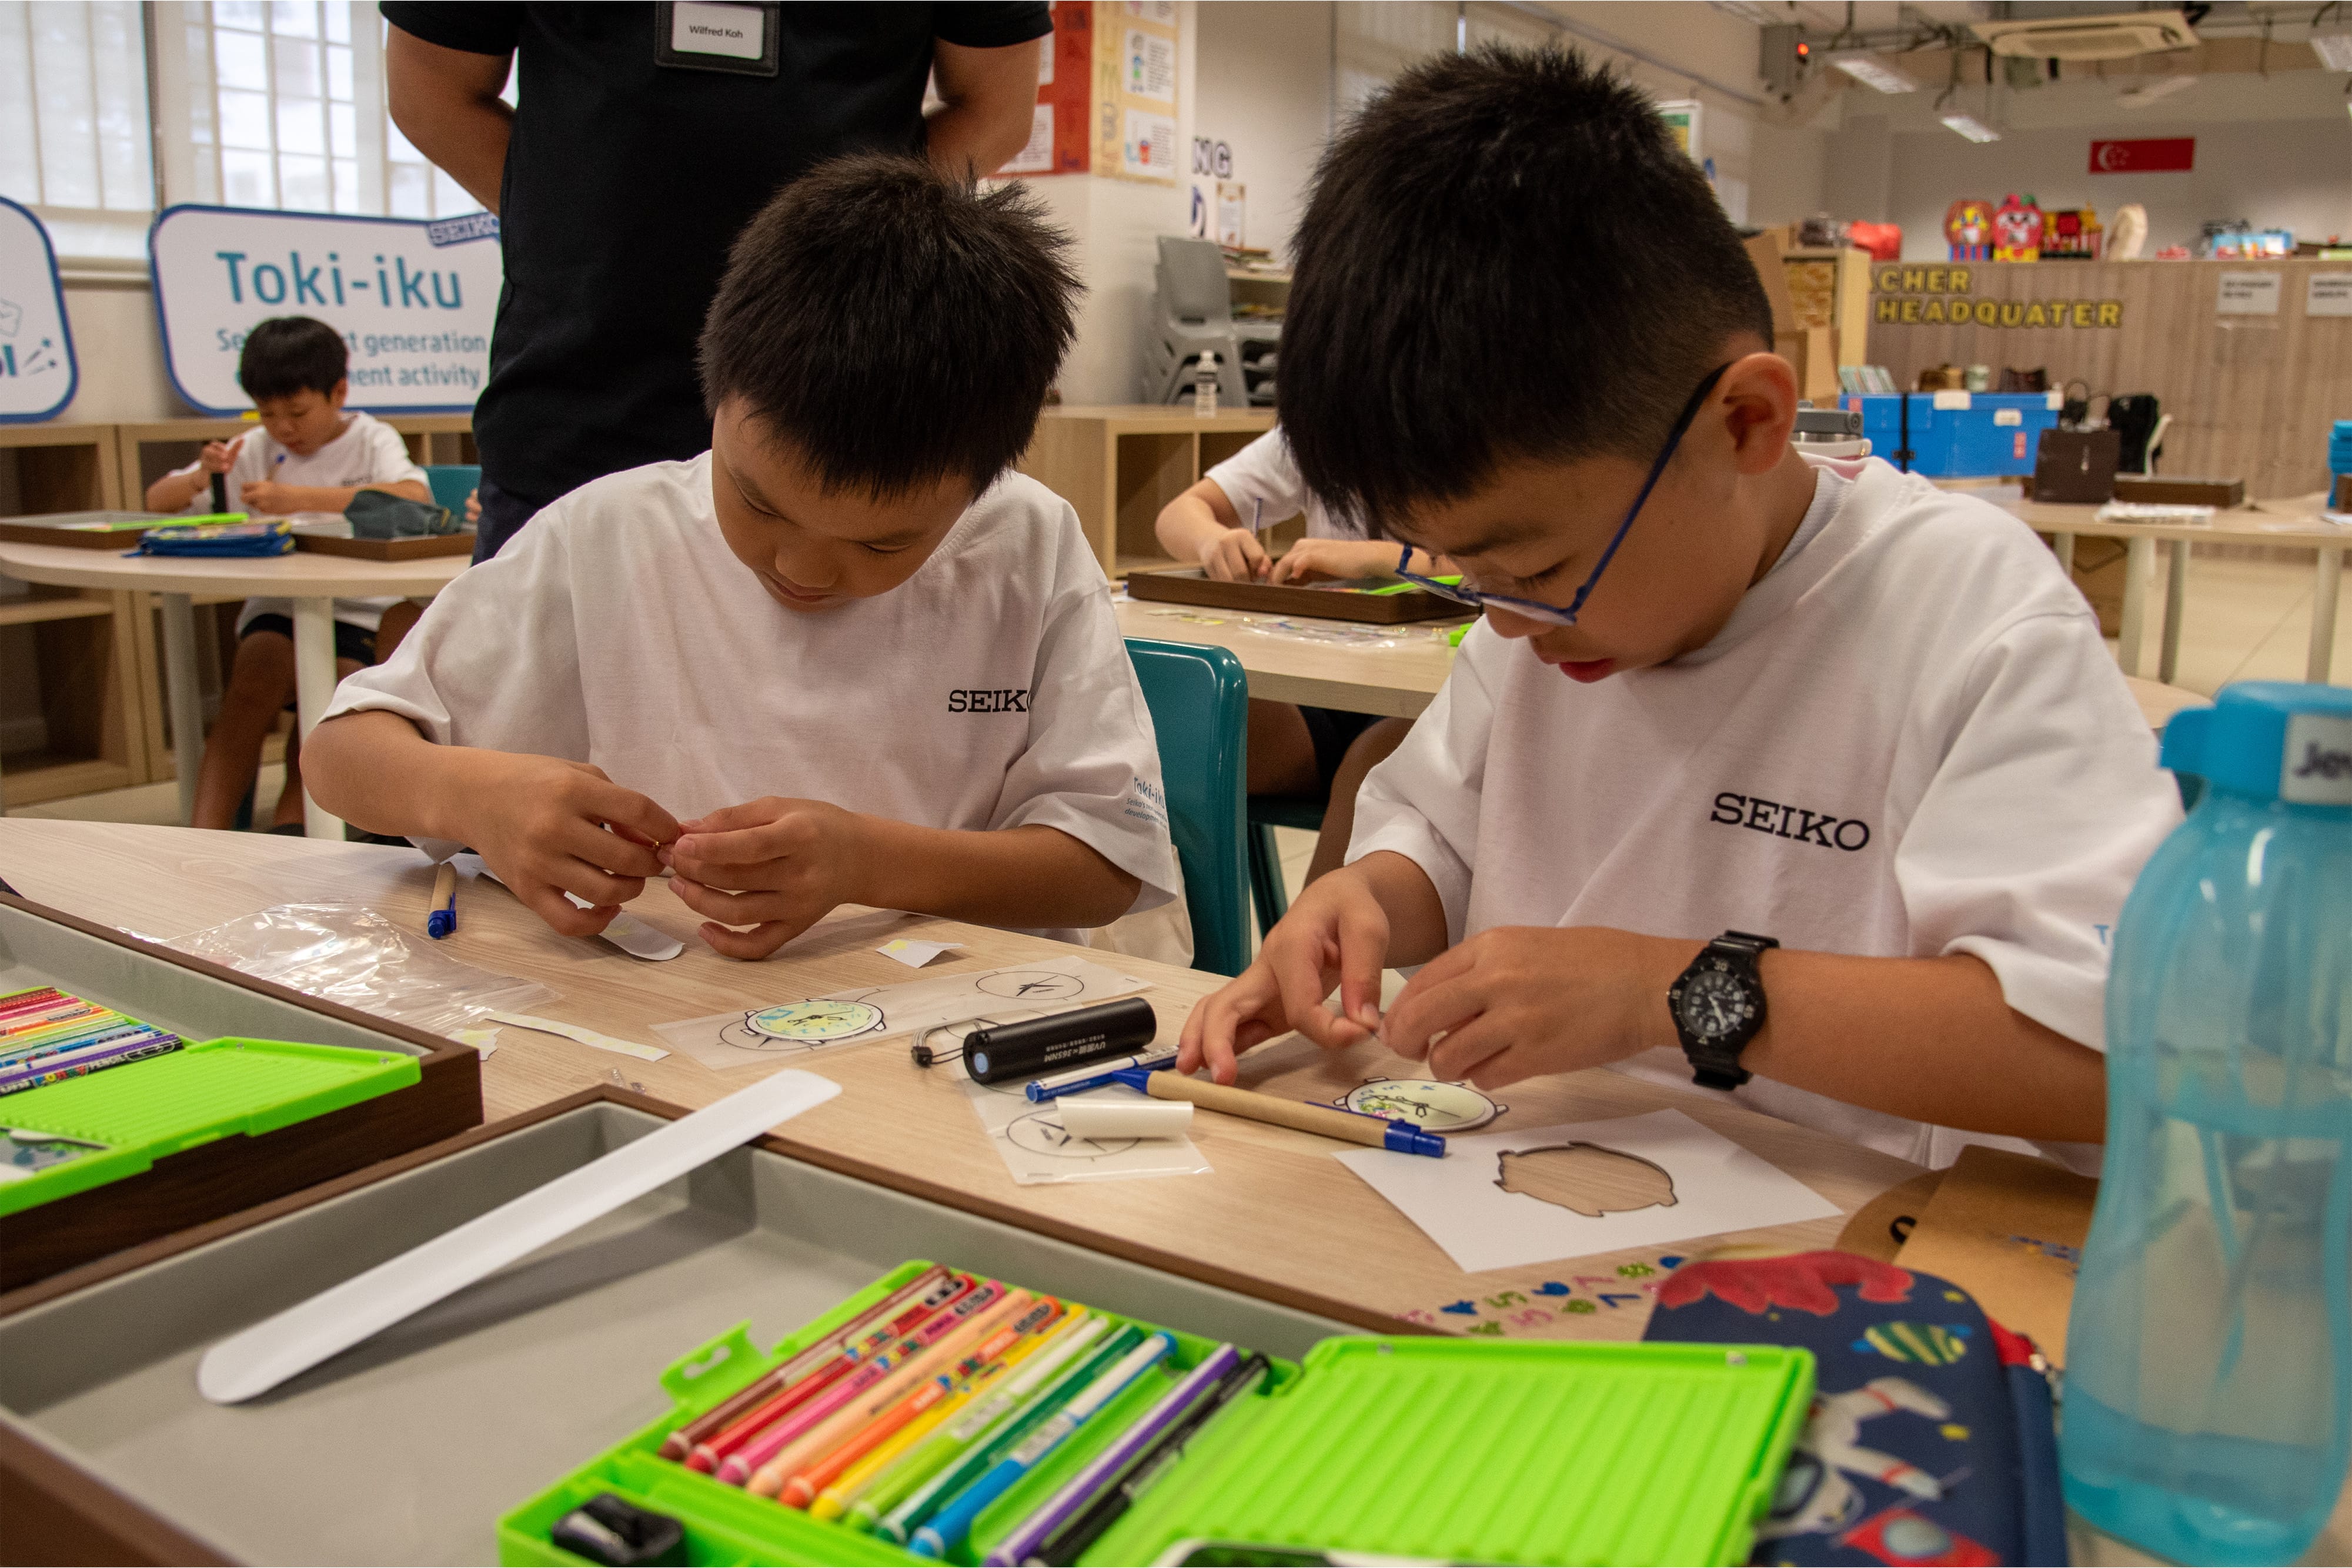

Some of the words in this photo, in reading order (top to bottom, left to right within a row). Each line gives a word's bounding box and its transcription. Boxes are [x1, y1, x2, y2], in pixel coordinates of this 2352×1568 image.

[689, 26, 723, 36] Wilfred
[725, 28, 743, 38] Koh
[215, 250, 463, 309] Toki-iku
[1869, 269, 1970, 293] CHER
[1877, 300, 2120, 327] HEADQUATER
[364, 329, 486, 357] generation
[398, 362, 480, 389] activity
[948, 688, 1031, 713] SEIK
[1710, 792, 1870, 851] SEIKO
